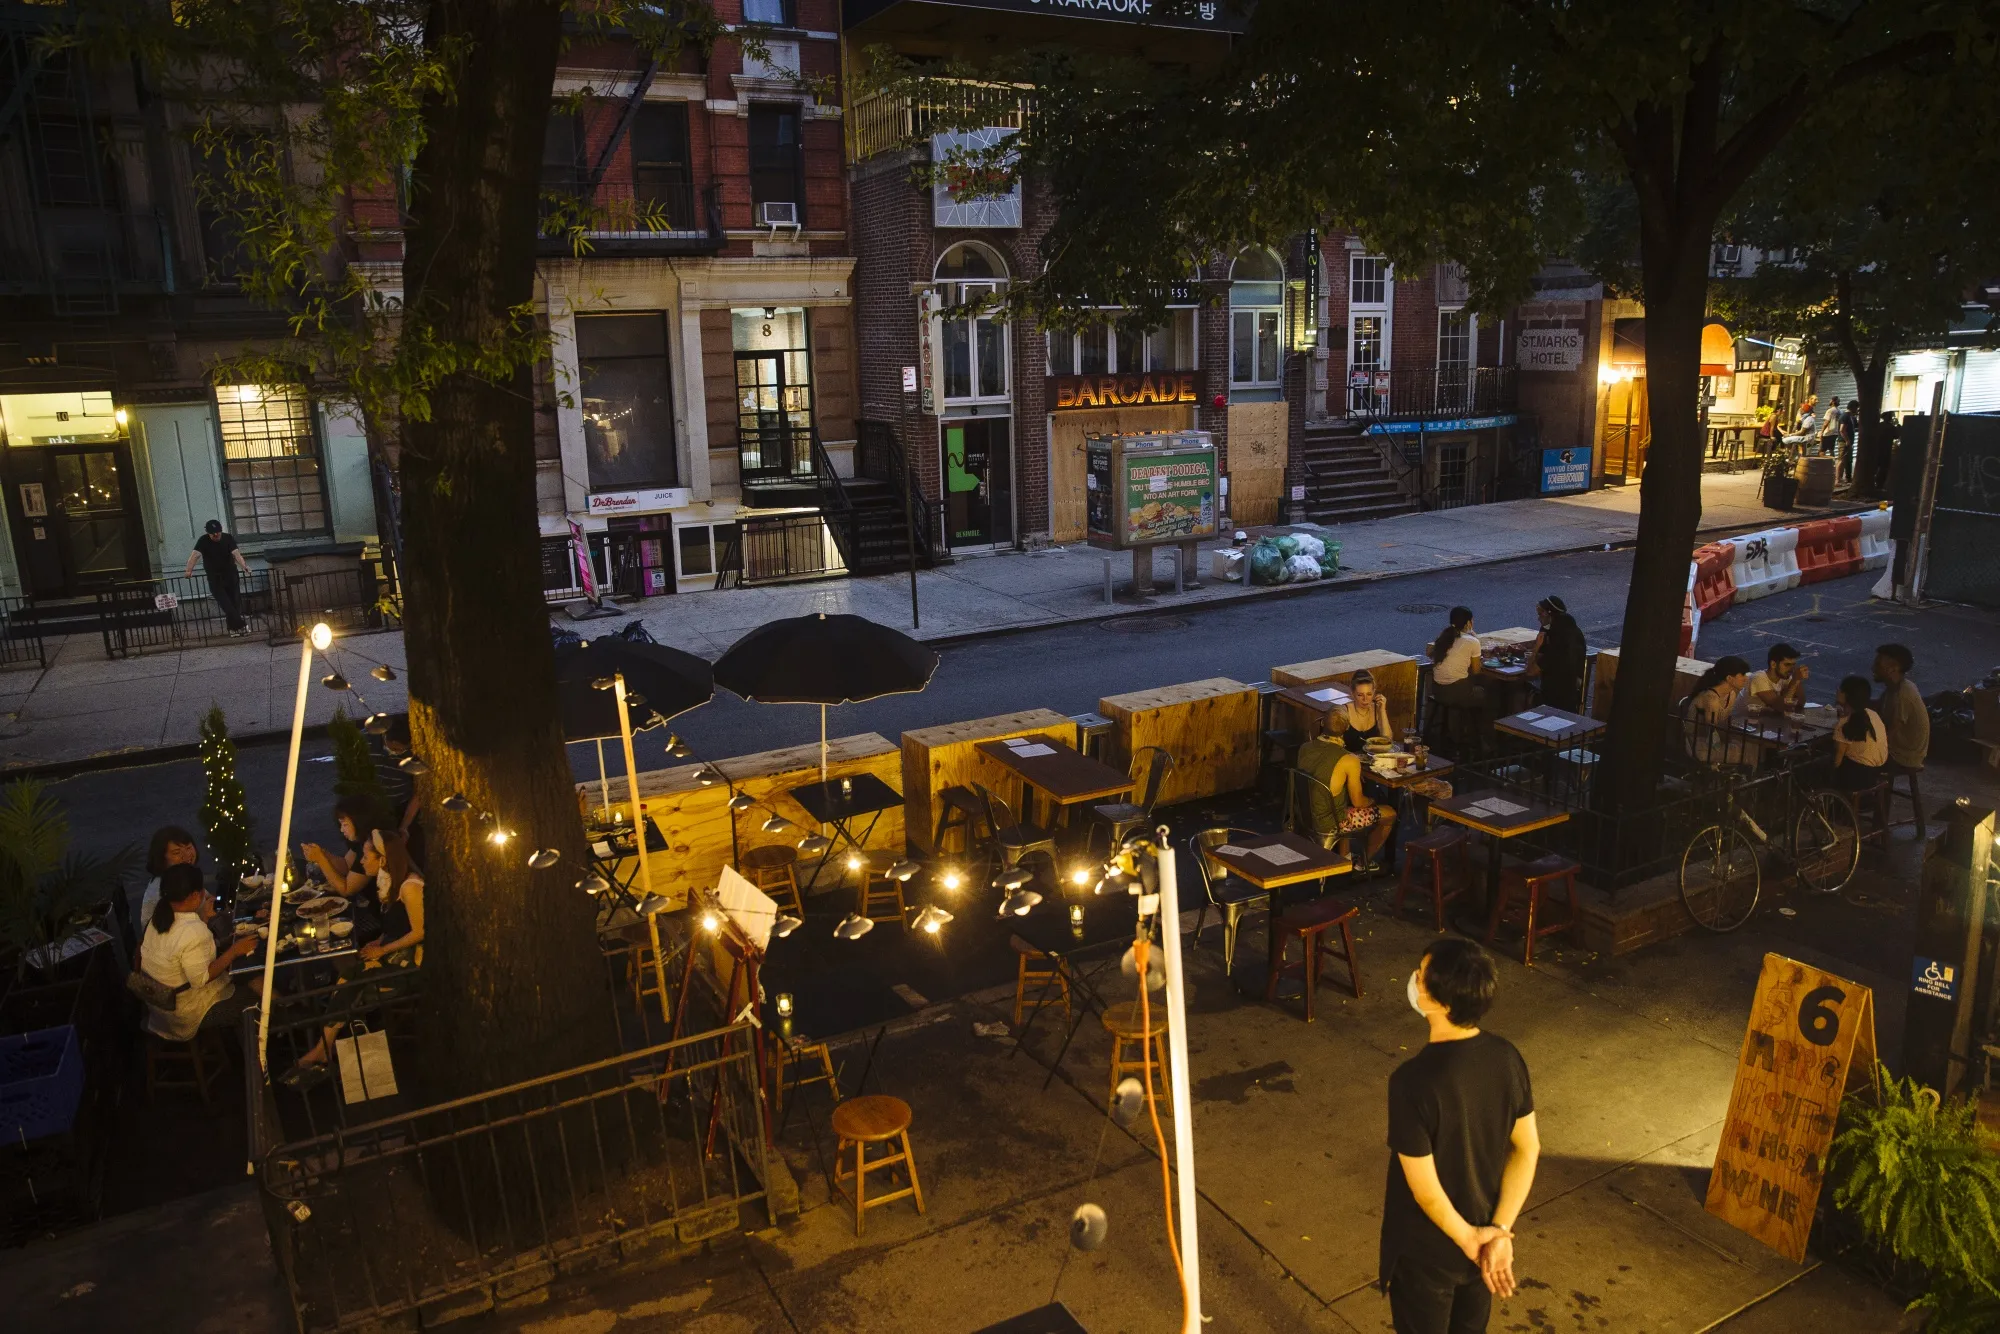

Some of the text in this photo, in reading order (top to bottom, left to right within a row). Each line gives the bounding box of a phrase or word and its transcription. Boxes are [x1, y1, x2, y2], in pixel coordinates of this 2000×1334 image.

[1049, 0, 1153, 15] AOKE
[762, 323, 772, 337] 8
[1521, 335, 1578, 348] ST.MARKS
[1530, 352, 1570, 365] HOTEL
[1057, 376, 1197, 408] BARCADE
[56, 411, 69, 422] 10
[971, 405, 978, 416] 6
[1130, 462, 1210, 480] DEAREST BODEGA,
[1131, 484, 1143, 492] YOU
[1174, 479, 1197, 487] HUMBLE
[654, 491, 674, 500] JUICE
[1143, 493, 1157, 501] INTO
[1918, 976, 1950, 990] RING BELL
[1927, 984, 1940, 992] FOR
[1914, 986, 1952, 1001] ASSISTANCE
